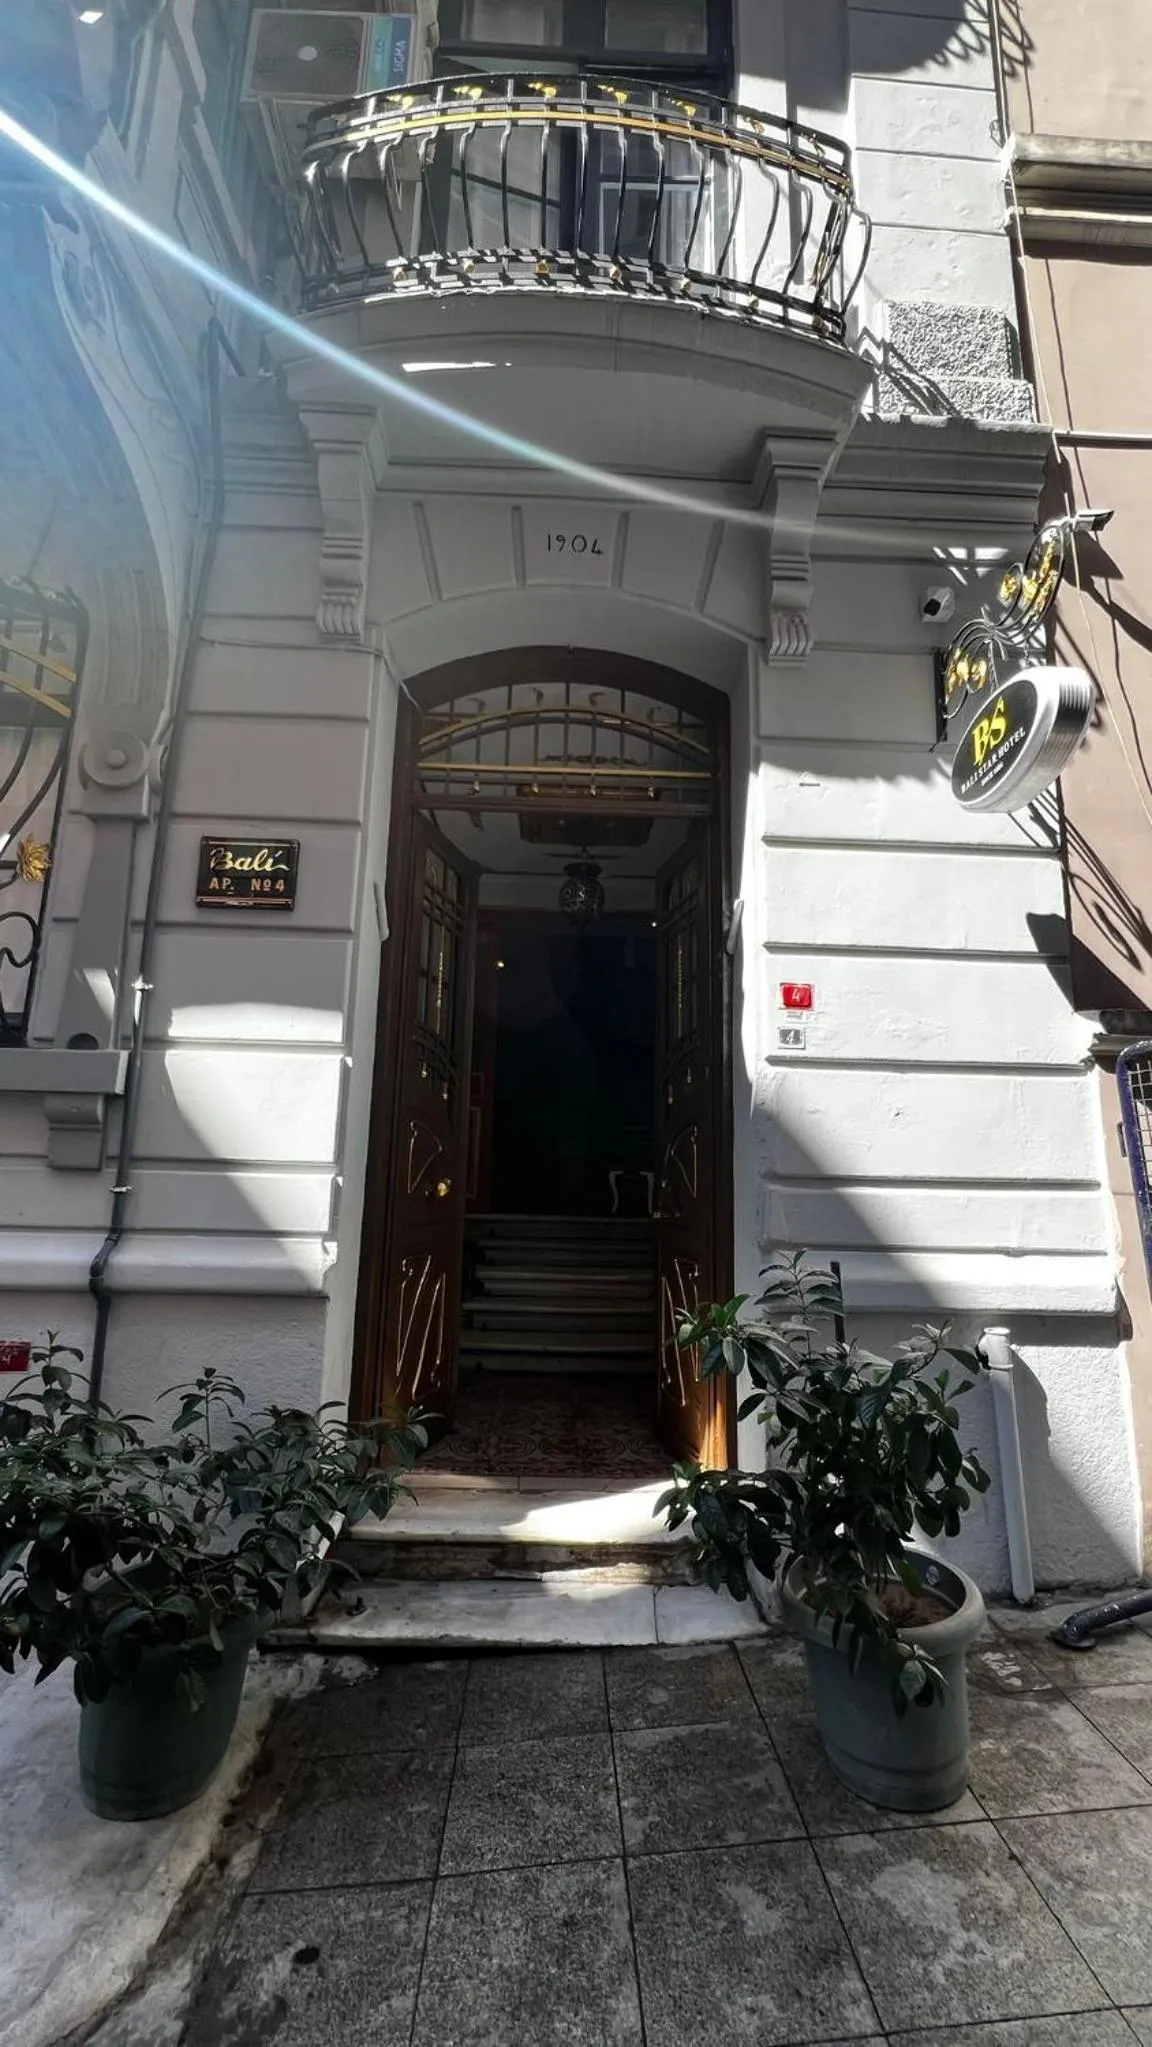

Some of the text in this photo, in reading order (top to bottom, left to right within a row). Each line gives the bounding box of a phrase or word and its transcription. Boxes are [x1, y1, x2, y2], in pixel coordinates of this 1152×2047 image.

[547, 533, 604, 555] 1904
[972, 695, 1007, 767] BS
[978, 752, 998, 778] STAR
[997, 726, 1026, 759] HOTEL
[791, 987, 801, 1003] 4
[785, 1030, 796, 1045] 4
